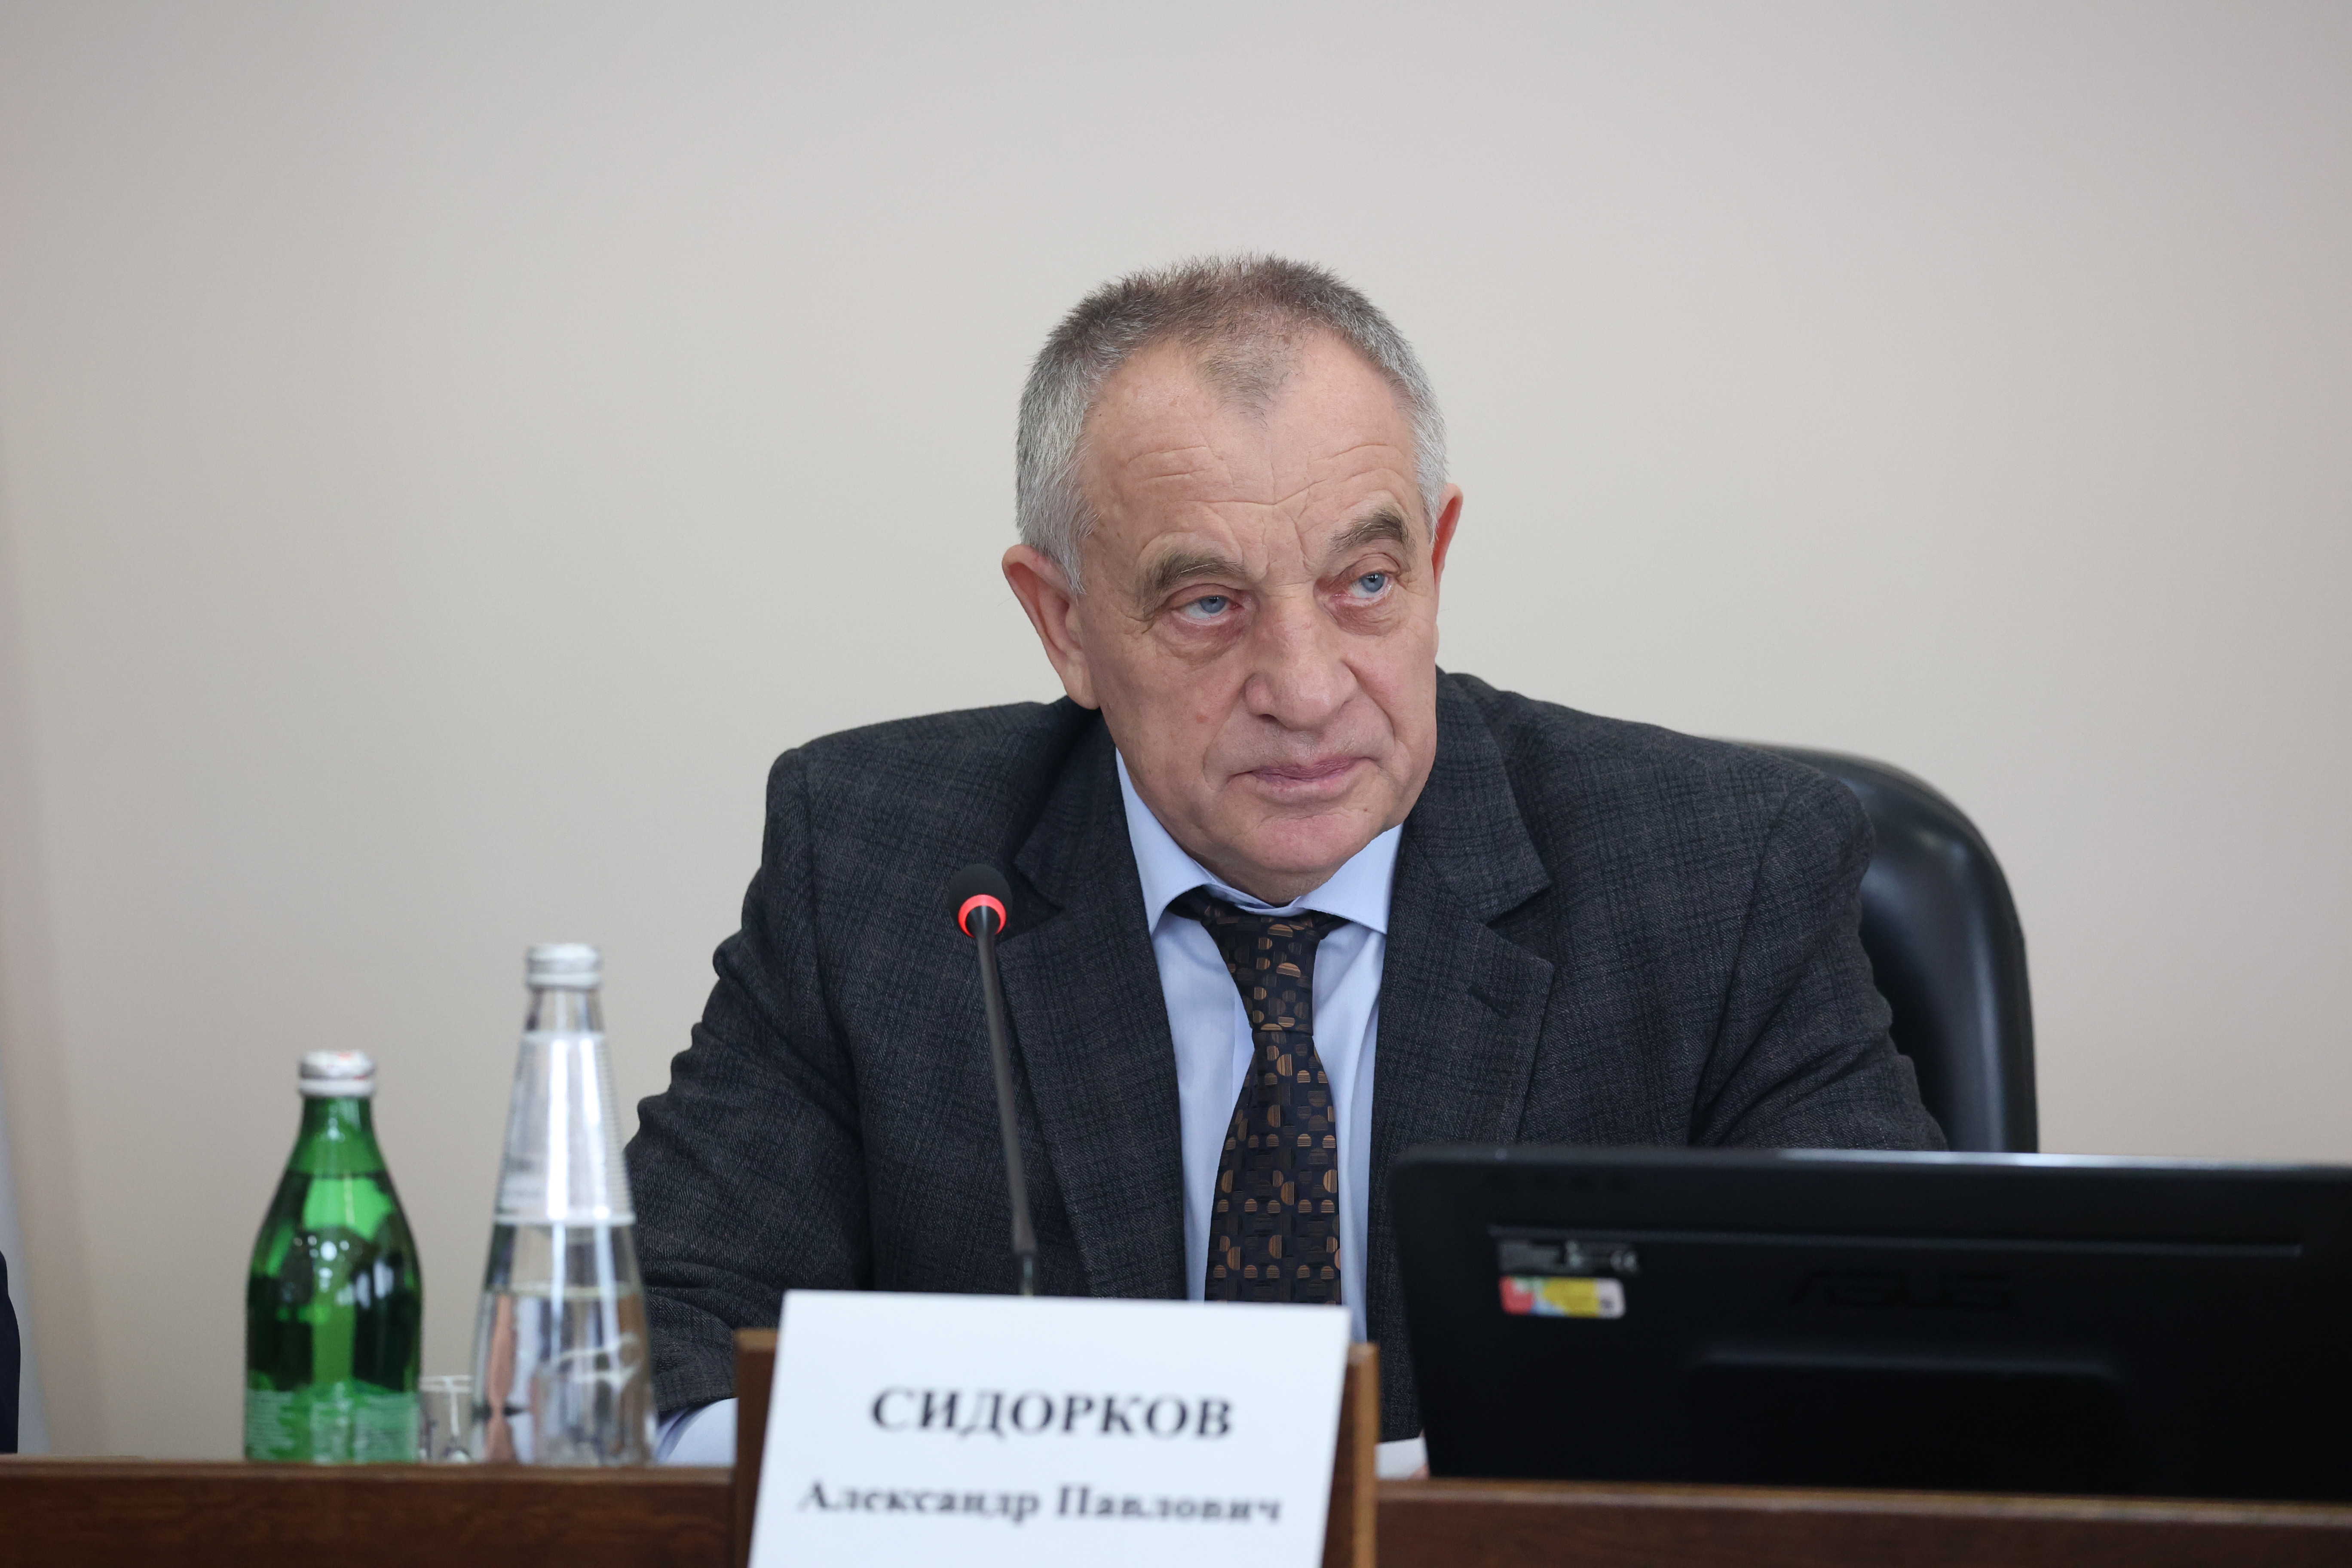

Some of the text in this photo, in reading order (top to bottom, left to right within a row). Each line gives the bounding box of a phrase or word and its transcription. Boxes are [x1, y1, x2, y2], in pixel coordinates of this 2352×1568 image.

[1788, 1267, 2012, 1311] ASUS
[869, 1388, 1233, 1439] СИДОРКОВ
[799, 1479, 1282, 1526] Александр Павлович
